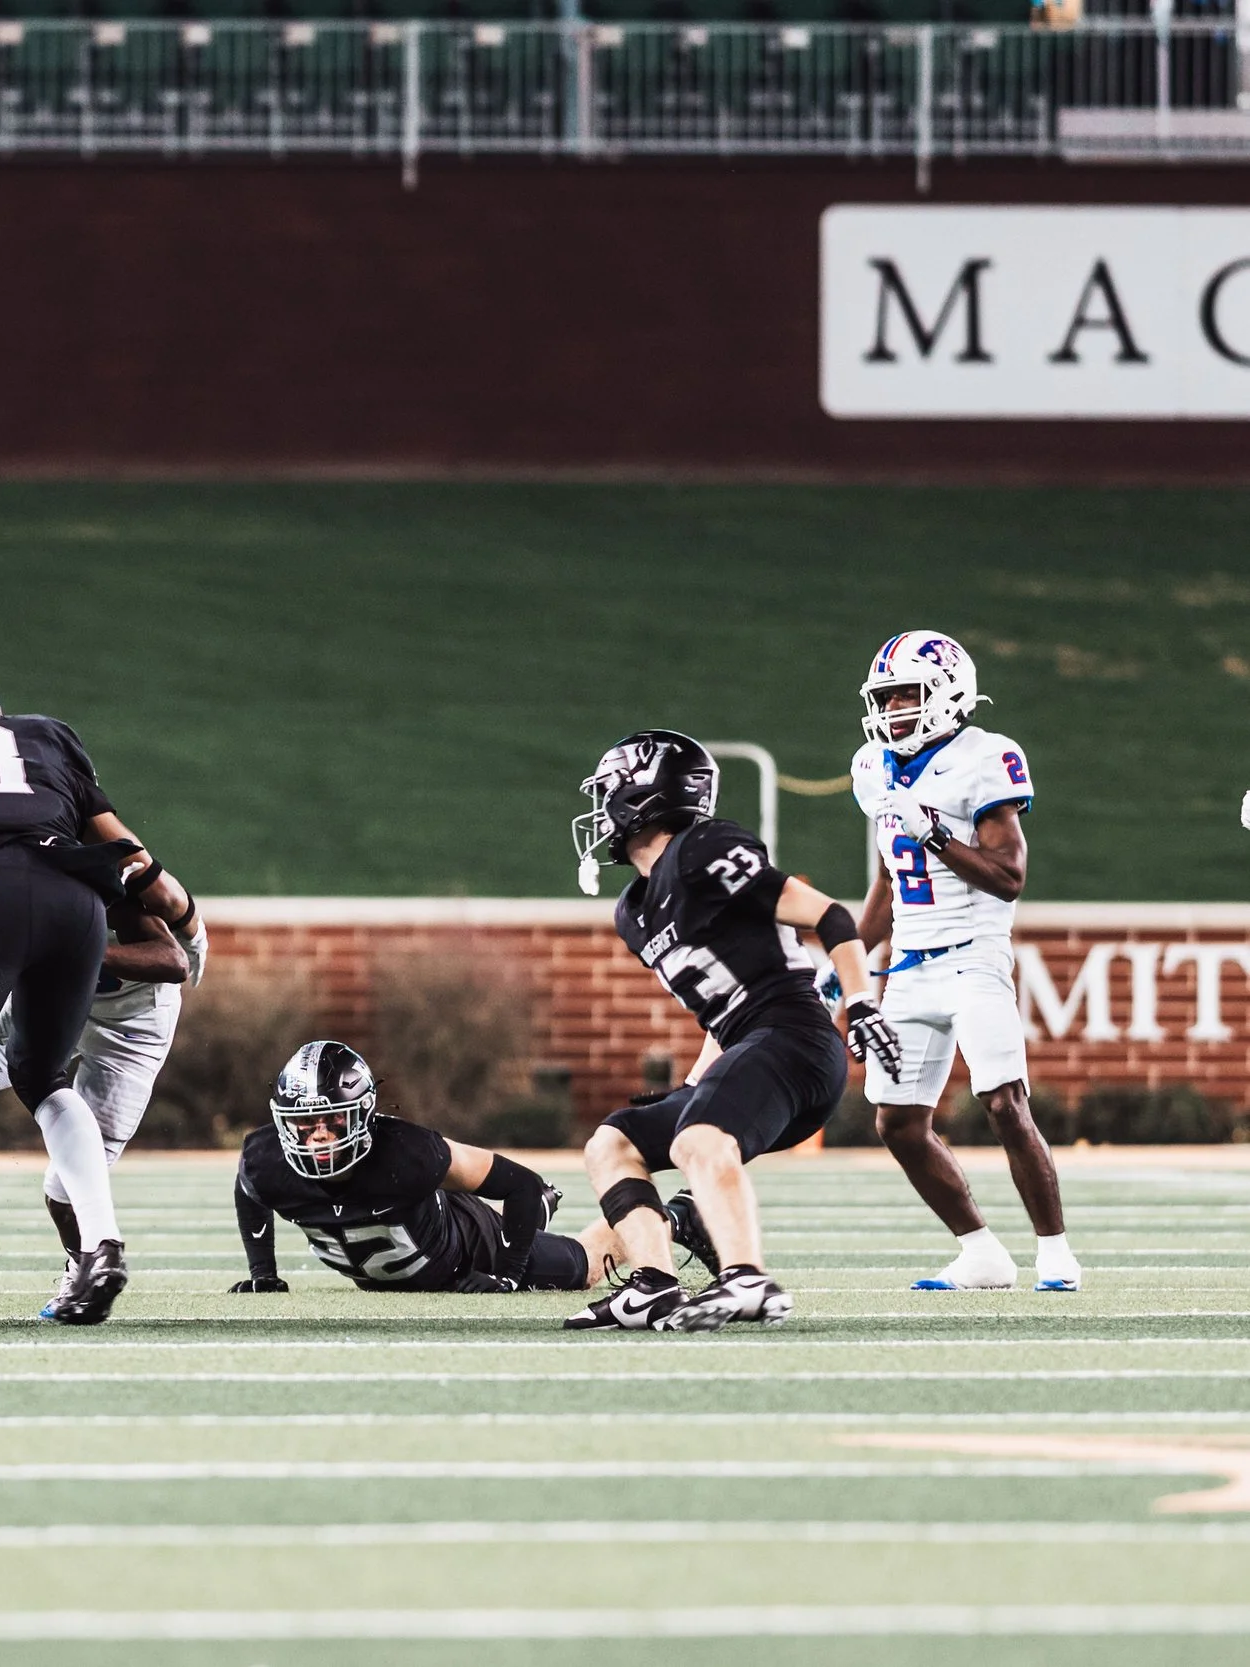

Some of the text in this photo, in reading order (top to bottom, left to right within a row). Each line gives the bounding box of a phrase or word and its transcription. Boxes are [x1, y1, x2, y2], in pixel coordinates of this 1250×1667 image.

[1002, 751, 1027, 785] 2
[706, 844, 762, 896] 23
[892, 834, 936, 905] 2
[1013, 941, 1250, 1042] MIT
[332, 1204, 343, 1217] V
